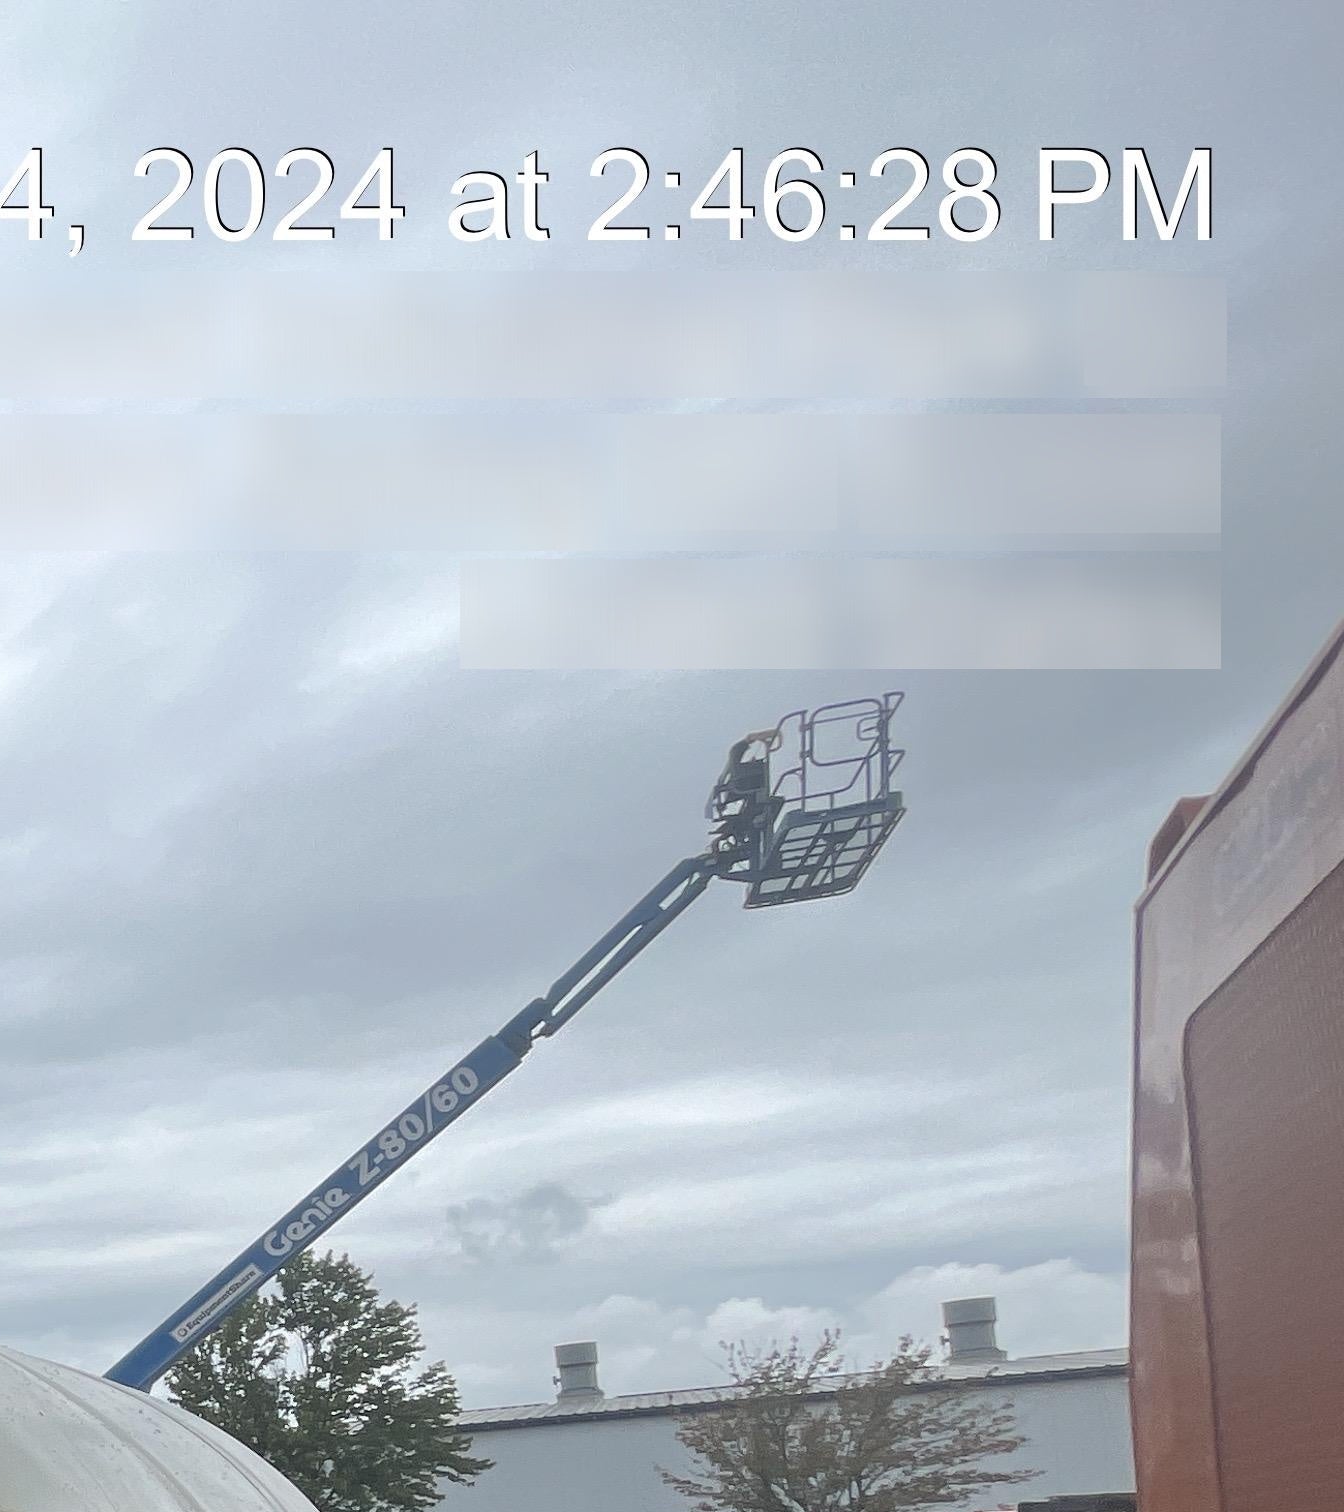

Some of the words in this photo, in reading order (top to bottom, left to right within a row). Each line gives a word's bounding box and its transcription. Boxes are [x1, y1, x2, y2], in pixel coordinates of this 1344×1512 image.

[264, 1187, 352, 1256] Genie
[349, 1066, 480, 1186] Z-80/60
[186, 1270, 257, 1330] EquipmentShare
